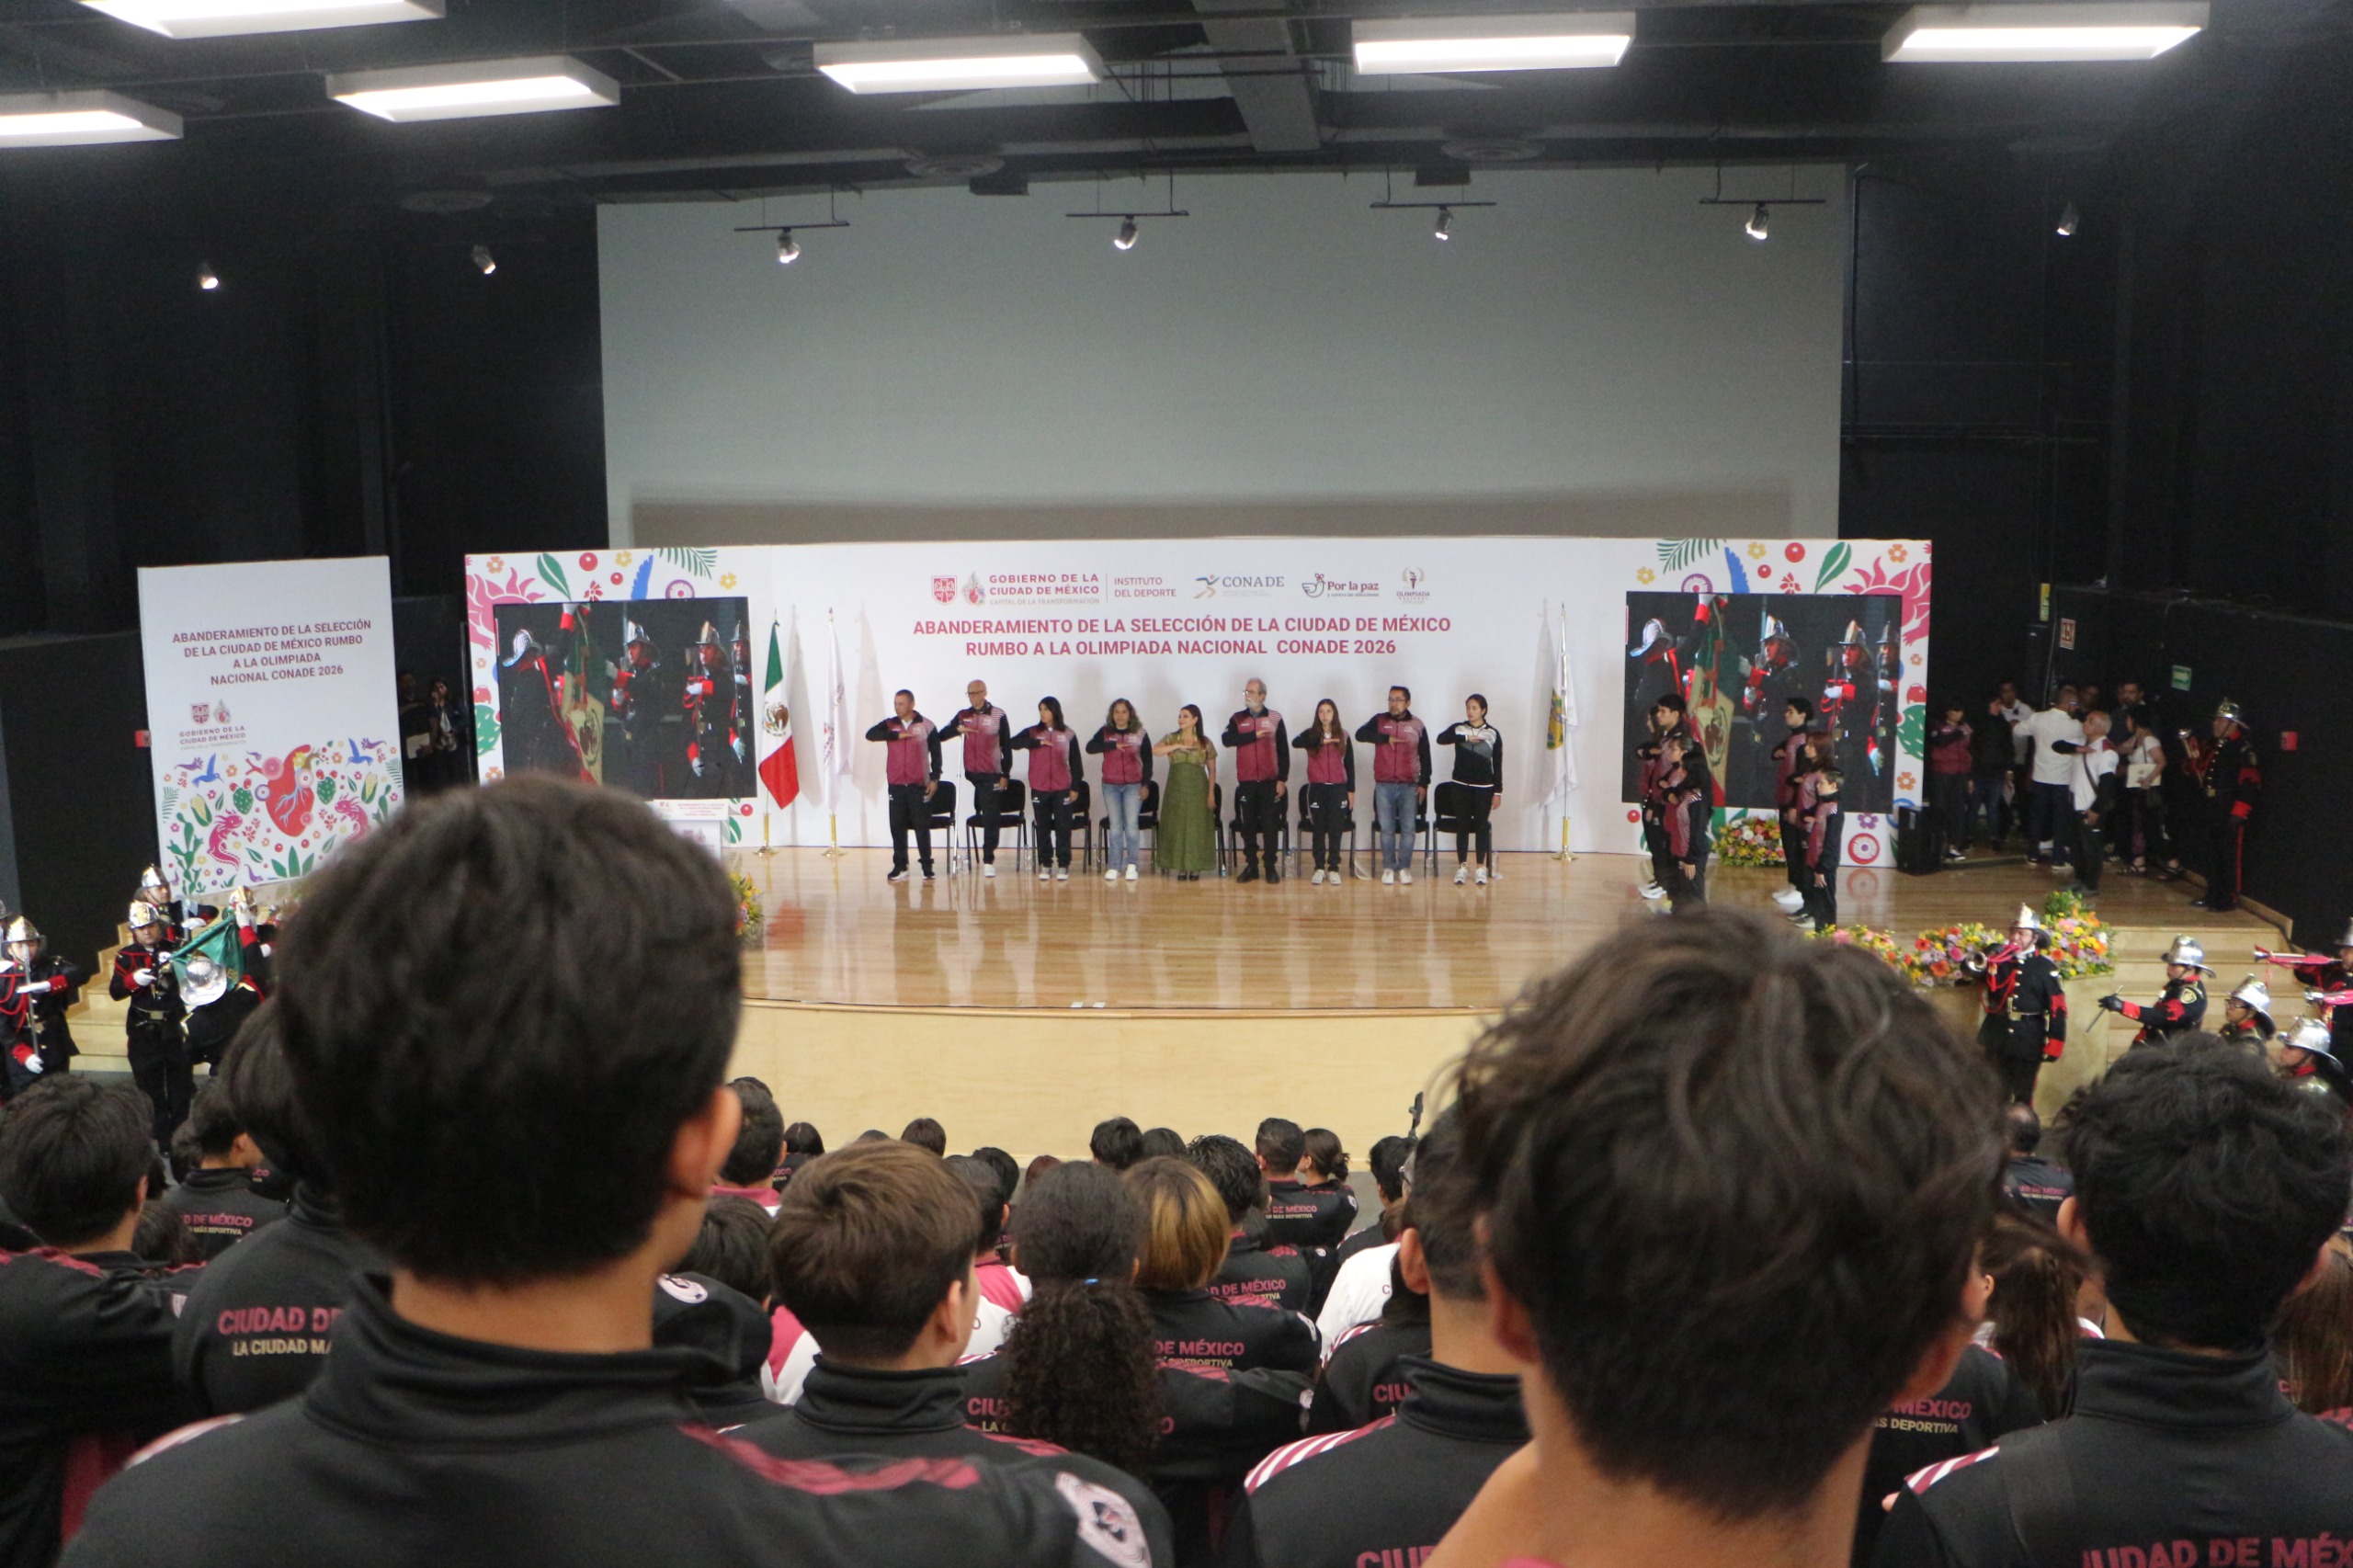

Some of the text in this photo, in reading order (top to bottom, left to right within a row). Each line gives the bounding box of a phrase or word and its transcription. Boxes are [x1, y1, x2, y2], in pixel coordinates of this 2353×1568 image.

[989, 574, 1099, 584] GOBIERNO DE LA
[1114, 577, 1163, 585] INSTITUTO
[1222, 576, 1285, 587] CONADE
[989, 584, 1099, 596] CIUDAD DE MÉXICO
[1114, 588, 1176, 597] DEL DEPORTE
[1327, 581, 1380, 593] Por la paz
[173, 619, 371, 643] ABANDERAMIENTO DE LA SELECCIÓN
[913, 613, 1451, 634] ABANDERAMIENTO DE LA SELECCIÓN DE LA CIUDAD DE MÉXICO
[184, 634, 363, 657] DE LA CIUDAD DE MÉXICO RUMBO
[966, 640, 1396, 655] RUMBO A LA OLIMPIADA NACIONAL CONADE 2026
[233, 653, 322, 669] A LA OLIMPIADA
[210, 665, 344, 686] NACIONAL CONADE 2026
[179, 728, 221, 737] GOBIERNO
[1285, 1204, 1318, 1213] MÉXICO
[194, 1214, 208, 1225] DE
[209, 1212, 254, 1227] MÉXICO
[1222, 1284, 1239, 1296] DE
[1241, 1278, 1287, 1293] MÉXICO
[217, 1306, 306, 1335] CIUDAD
[233, 1341, 249, 1357] LA
[251, 1338, 309, 1356] CIUDAD
[1154, 1338, 1245, 1356] DE MÉXICO
[982, 1421, 999, 1432] LA
[1890, 1418, 1959, 1434] DEPORTIVA
[2210, 1538, 2260, 1568] DE
